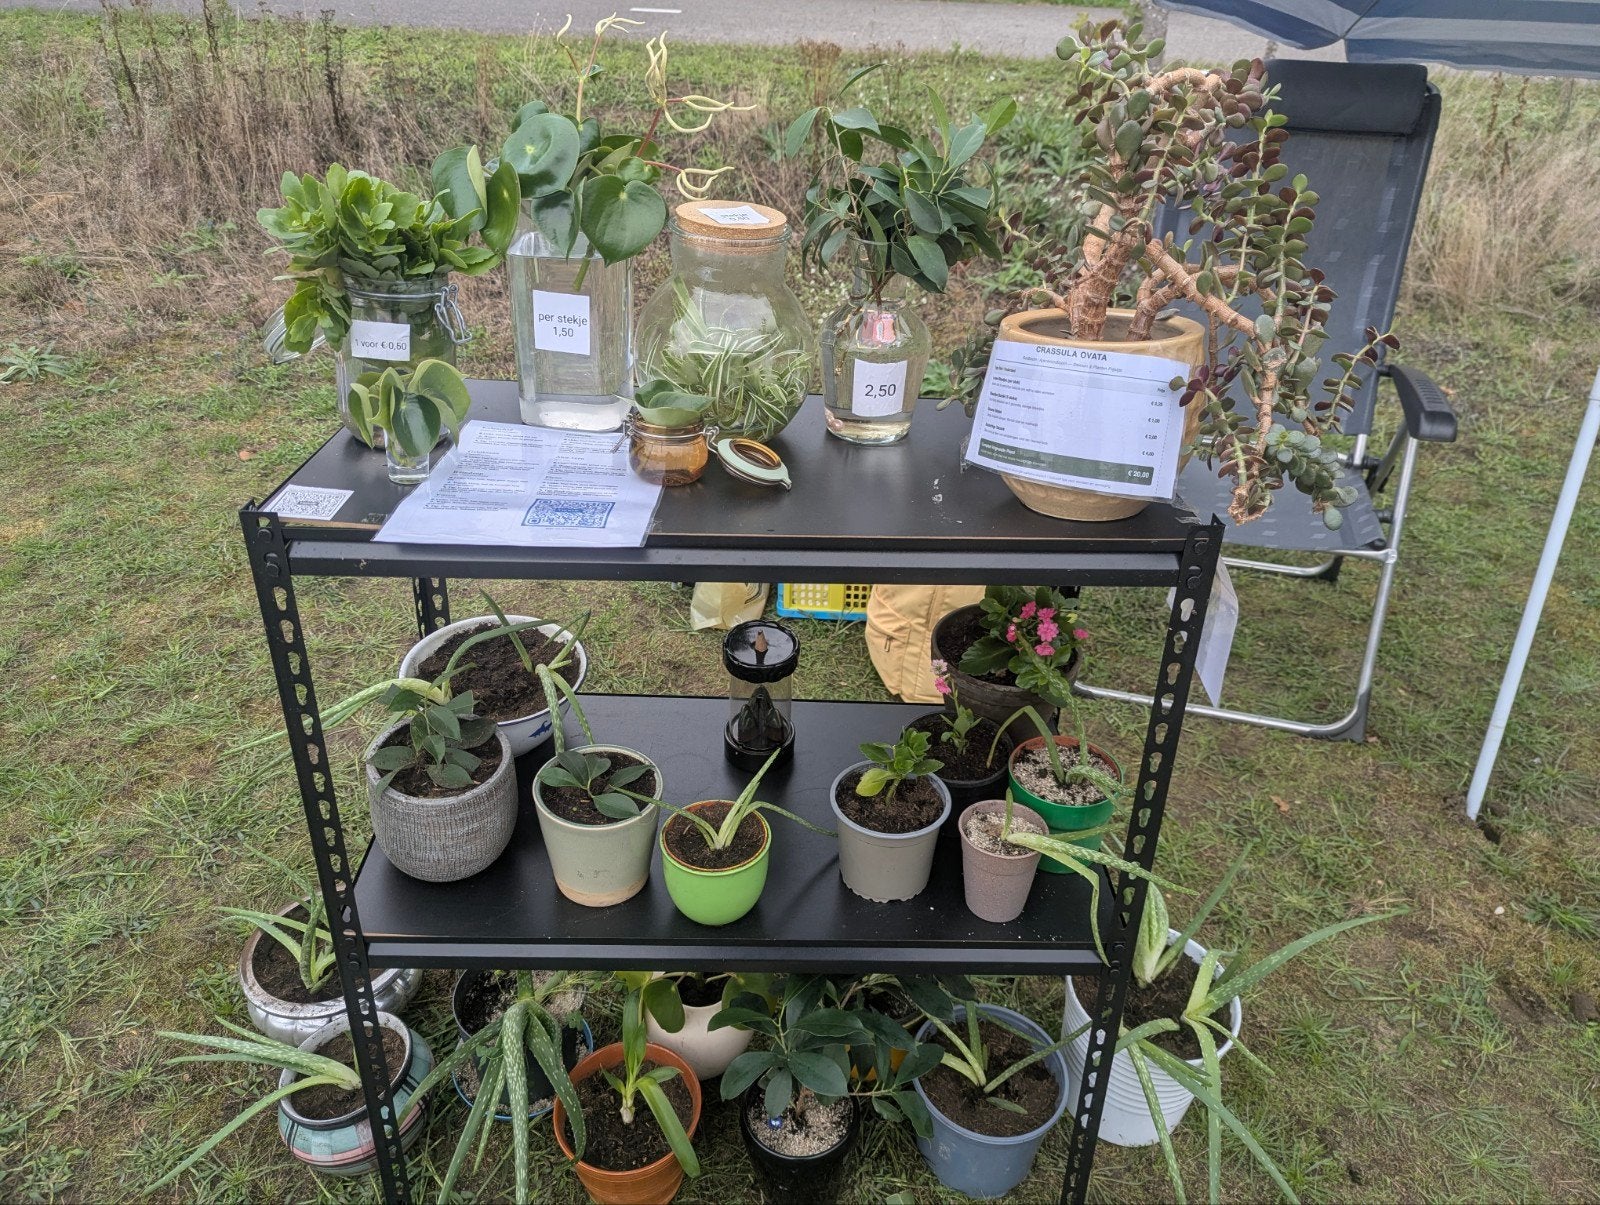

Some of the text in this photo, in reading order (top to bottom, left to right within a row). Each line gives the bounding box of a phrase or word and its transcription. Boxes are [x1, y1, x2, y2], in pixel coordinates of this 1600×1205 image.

[538, 313, 588, 327] per stekje
[552, 326, 575, 338] 1,50
[354, 338, 408, 351] 1 voor € 0,50
[1036, 346, 1108, 362] CRASSULA OVATA
[864, 383, 897, 399] 2,50
[1133, 470, 1150, 479] 20,00
